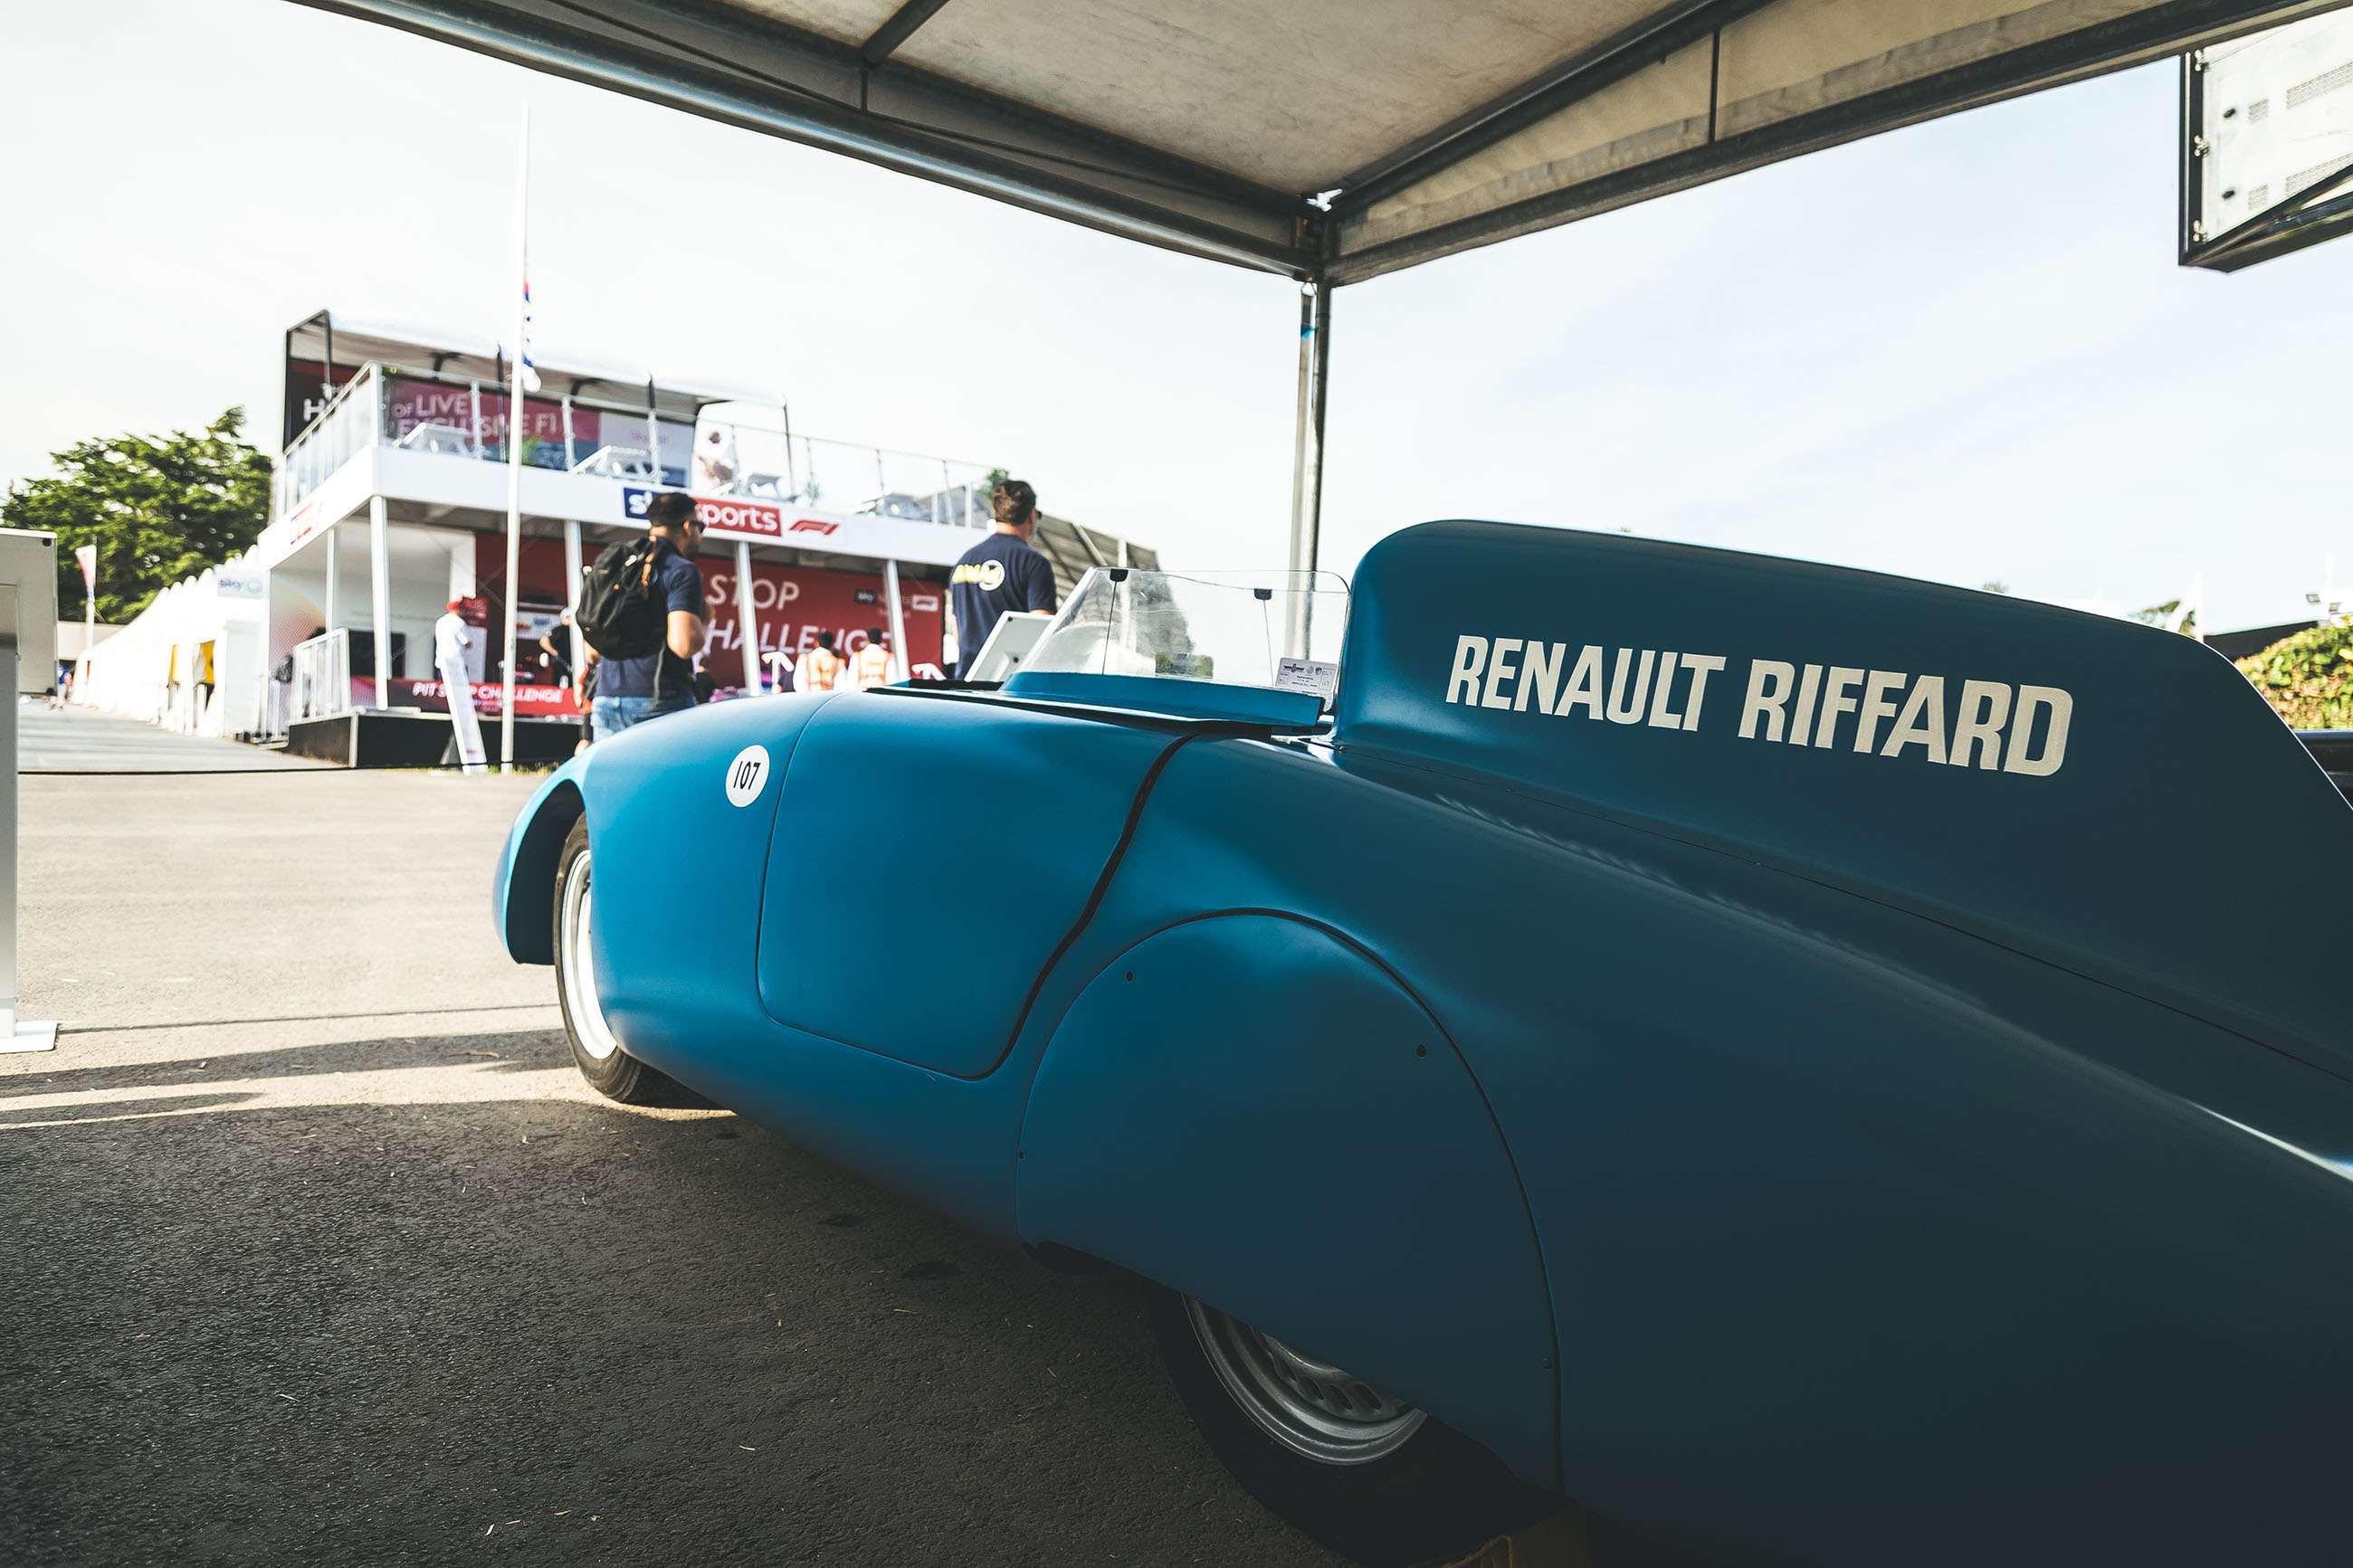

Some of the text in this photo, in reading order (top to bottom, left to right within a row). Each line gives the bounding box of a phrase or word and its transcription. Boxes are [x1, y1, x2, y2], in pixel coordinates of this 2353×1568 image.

[415, 394, 470, 417] LIVE
[479, 686, 564, 704] CHLLENGE
[1445, 634, 2074, 777] RENAULT RIFFARD
[733, 761, 761, 790] 107
